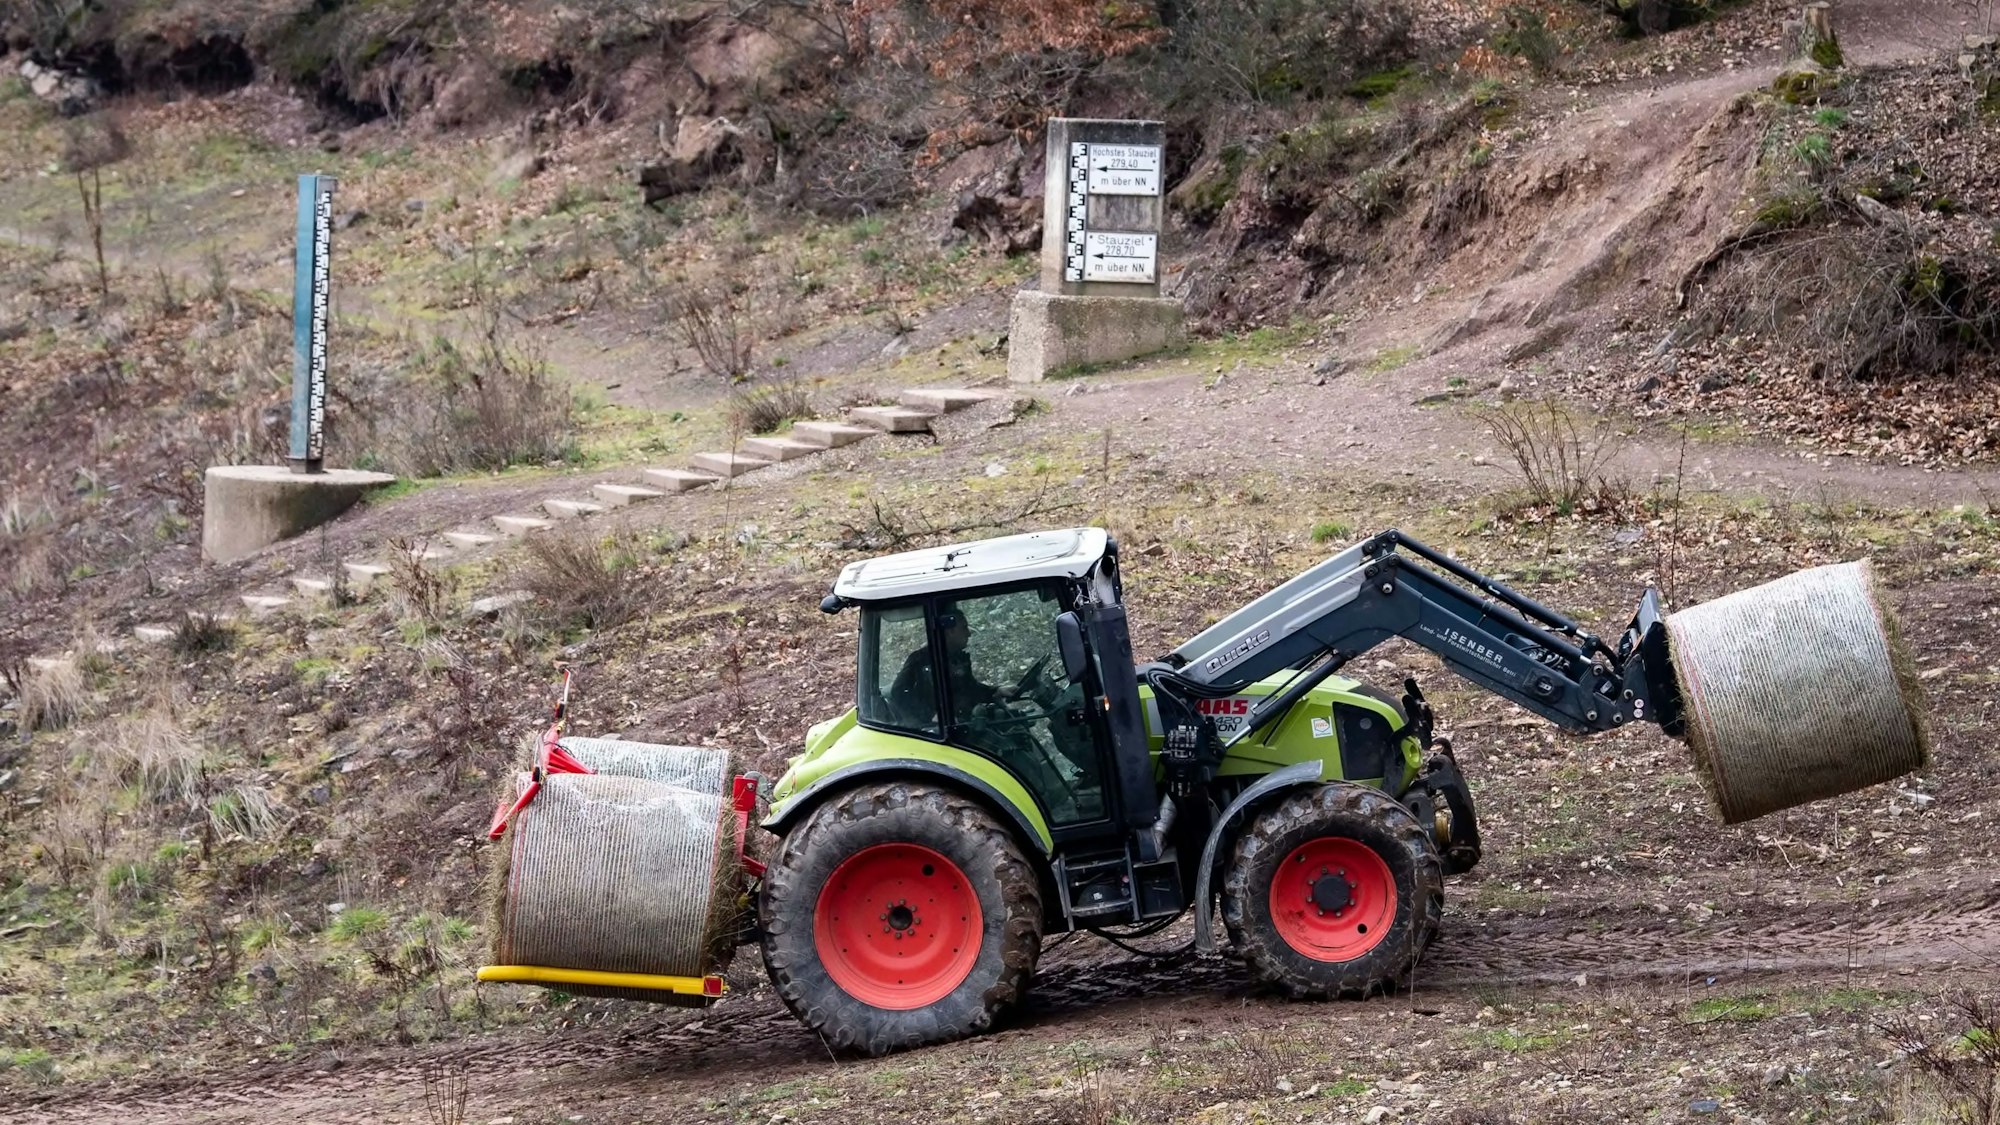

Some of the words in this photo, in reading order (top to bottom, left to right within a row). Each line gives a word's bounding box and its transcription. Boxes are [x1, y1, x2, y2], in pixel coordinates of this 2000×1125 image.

[1128, 148, 1157, 158] Stauziel
[1112, 176, 1132, 186] über
[1135, 177, 1147, 186] NN
[1097, 235, 1145, 246] Stauziel
[1132, 264, 1145, 273] NN
[1444, 628, 1503, 663] ISENBER
[1205, 630, 1270, 674] Quicke
[1195, 699, 1248, 714] AAS
[1215, 716, 1243, 725] 420
